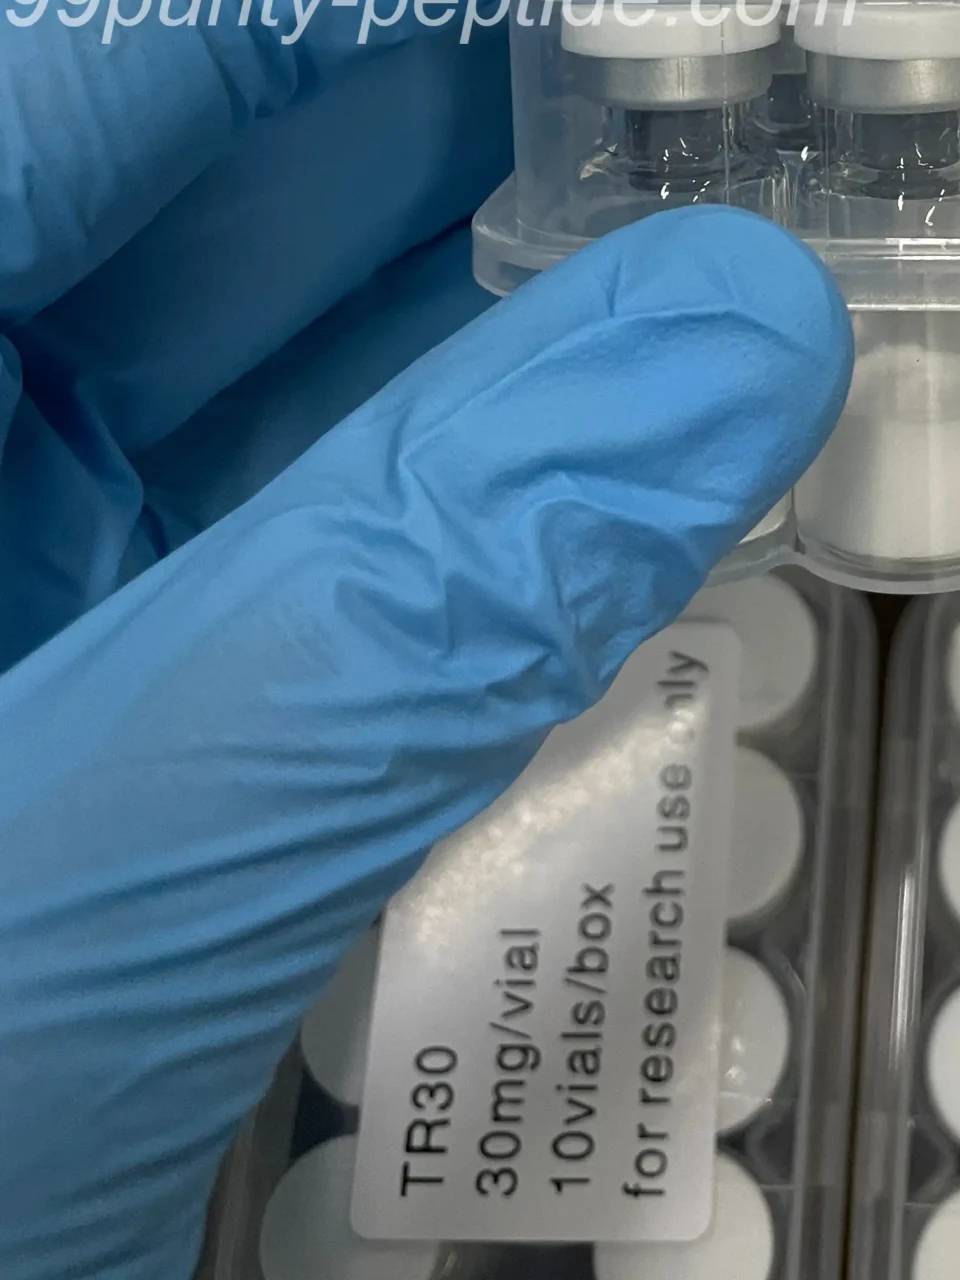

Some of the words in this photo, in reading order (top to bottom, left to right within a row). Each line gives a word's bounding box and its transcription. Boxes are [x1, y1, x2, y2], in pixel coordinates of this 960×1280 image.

[657, 766, 691, 854] use
[473, 930, 542, 1200] 30mg/vial
[549, 884, 615, 1195] 10vials/box
[639, 871, 683, 1106] research
[400, 1047, 457, 1197] TR30
[621, 1123, 668, 1199] for
